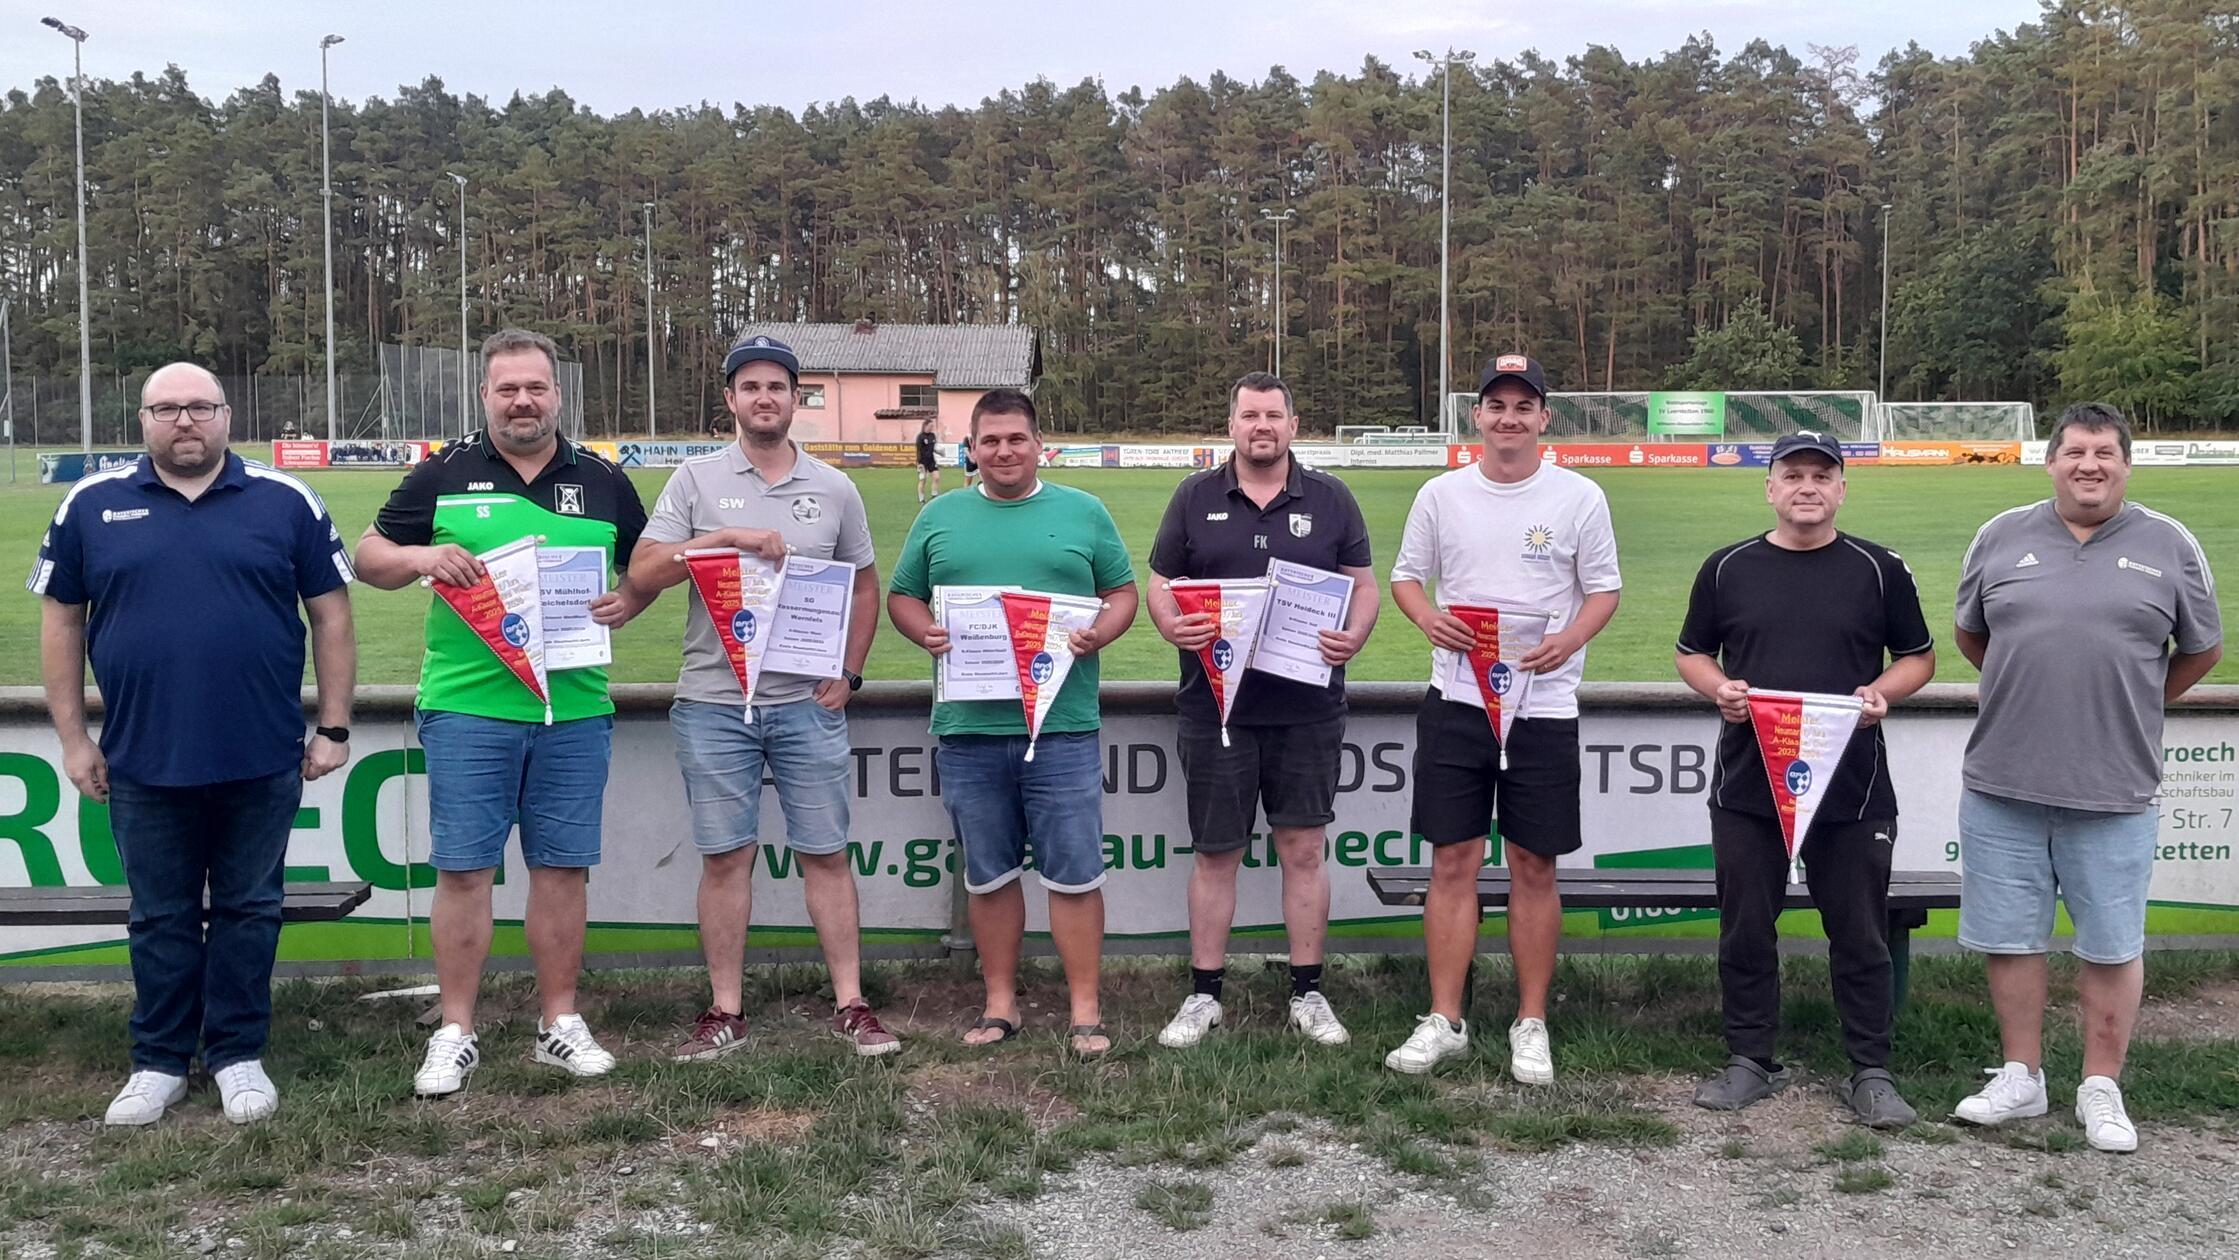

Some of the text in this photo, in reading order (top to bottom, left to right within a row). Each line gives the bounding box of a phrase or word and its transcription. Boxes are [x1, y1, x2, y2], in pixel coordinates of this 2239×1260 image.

[644, 446, 678, 456] HAHN
[804, 443, 843, 452] Gaststätte
[863, 443, 898, 452] Goldenen
[1561, 453, 1612, 466] Sparkasse
[1648, 453, 1699, 466] Sparkasse
[467, 482, 494, 490] JAKO
[718, 498, 745, 509] SW
[476, 505, 490, 518] SS
[1206, 512, 1229, 521] JAKO
[1253, 534, 1268, 549] FK
[1277, 598, 1292, 608] TSV
[968, 623, 998, 631] FC/DJK
[2219, 770, 2235, 782] im
[2172, 808, 2233, 829] Str. 7
